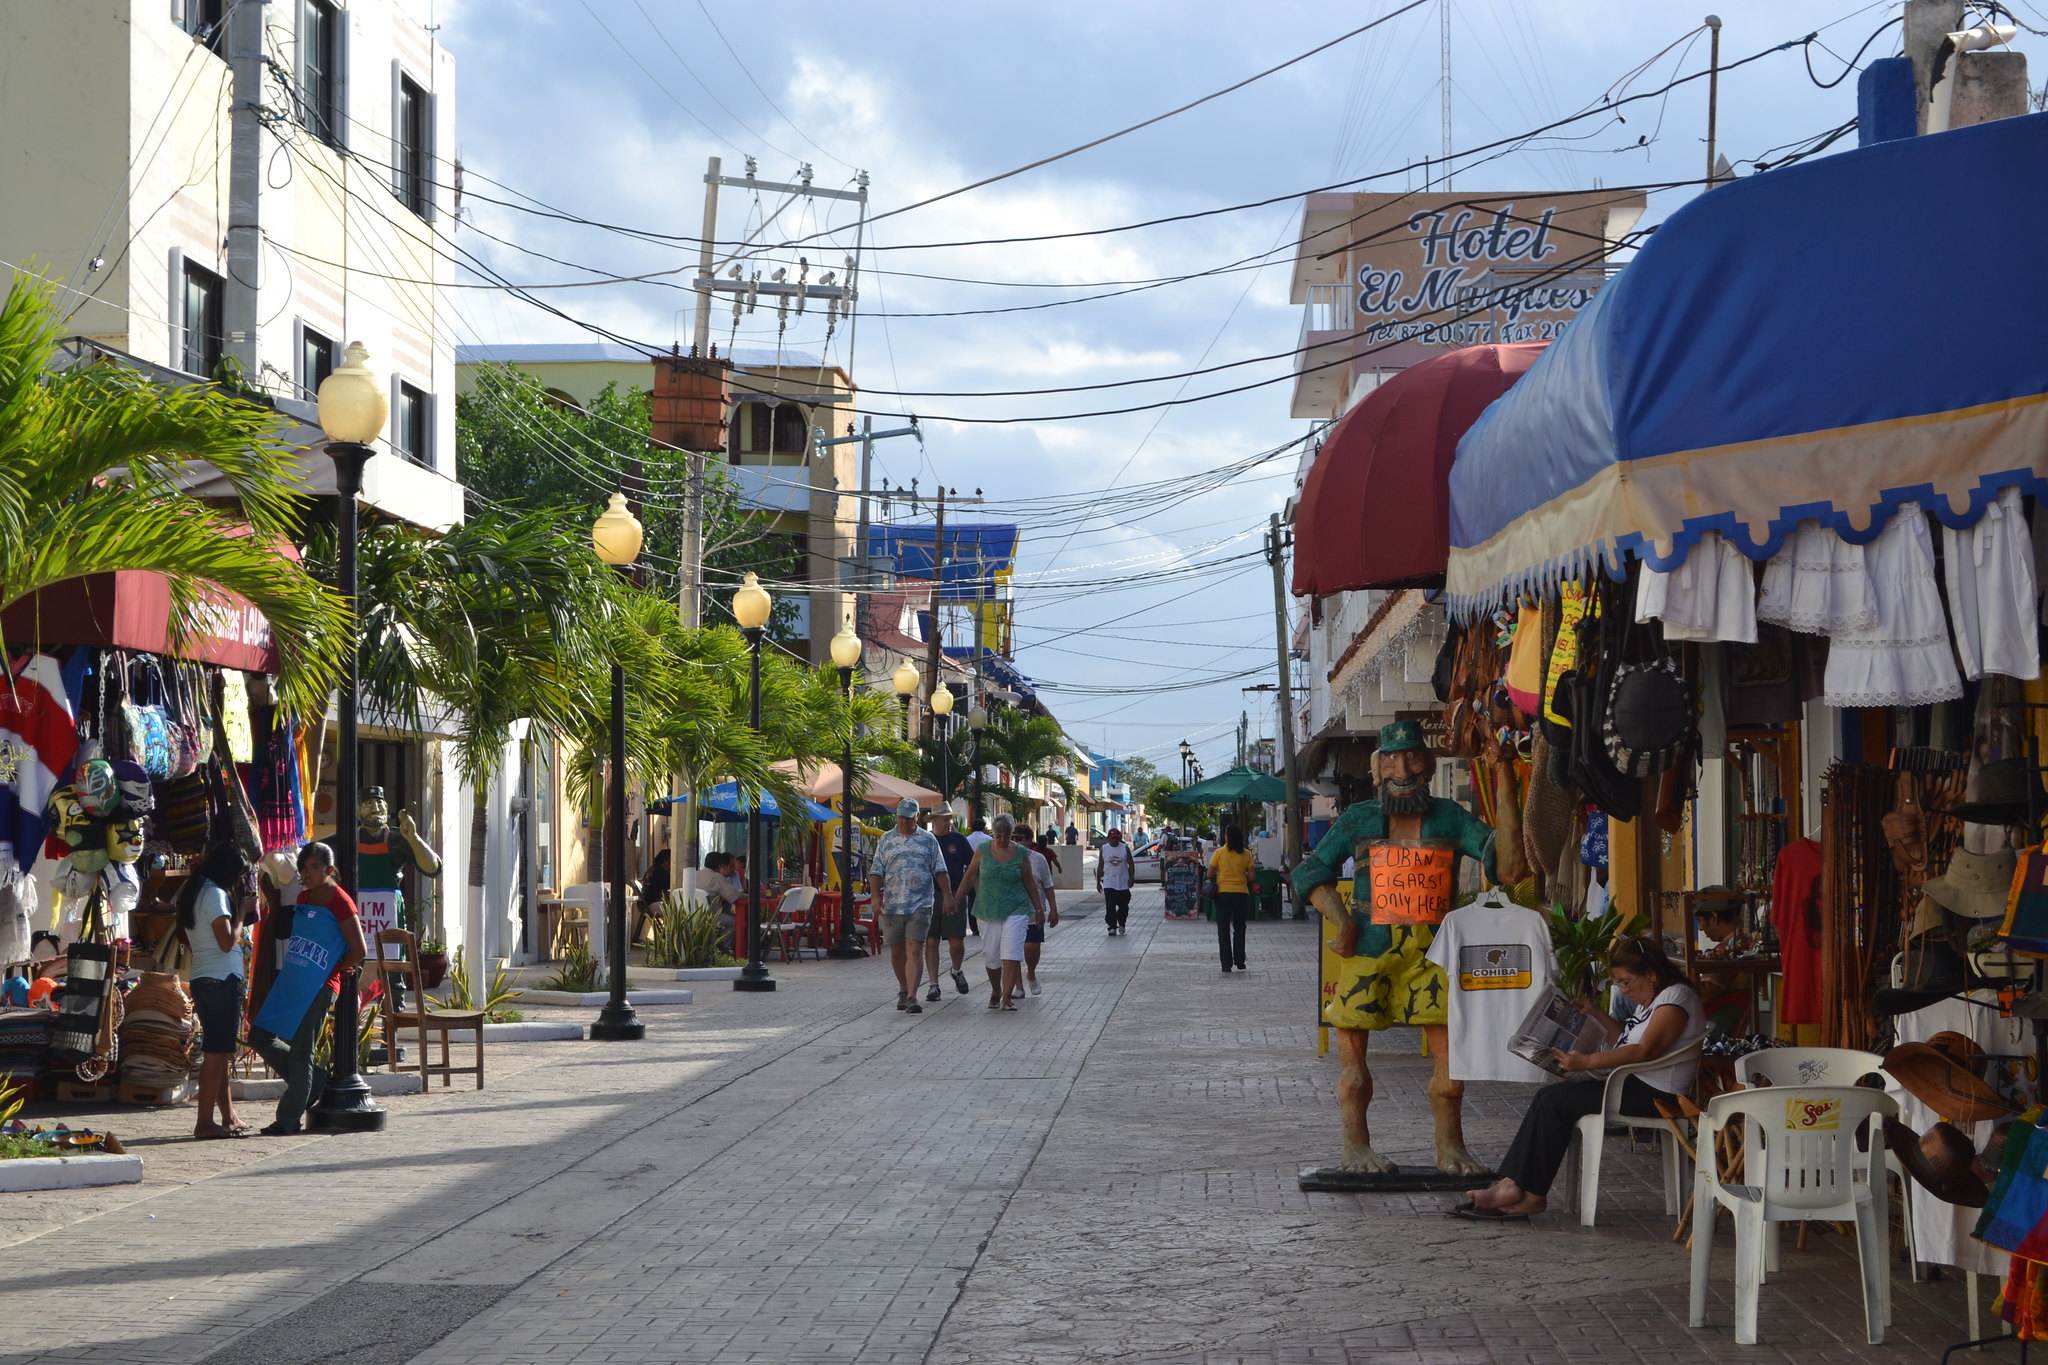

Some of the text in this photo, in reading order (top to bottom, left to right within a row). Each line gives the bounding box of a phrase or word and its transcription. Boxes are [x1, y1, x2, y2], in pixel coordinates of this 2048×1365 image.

[1408, 203, 1557, 266] Hotel
[1358, 265, 1403, 315] El
[1501, 322, 1535, 344] Fax
[1373, 848, 1435, 868] CUBAN
[1375, 873, 1442, 891] CIGARS!
[1418, 895, 1449, 915] HERE
[1473, 968, 1517, 977] COHIBA
